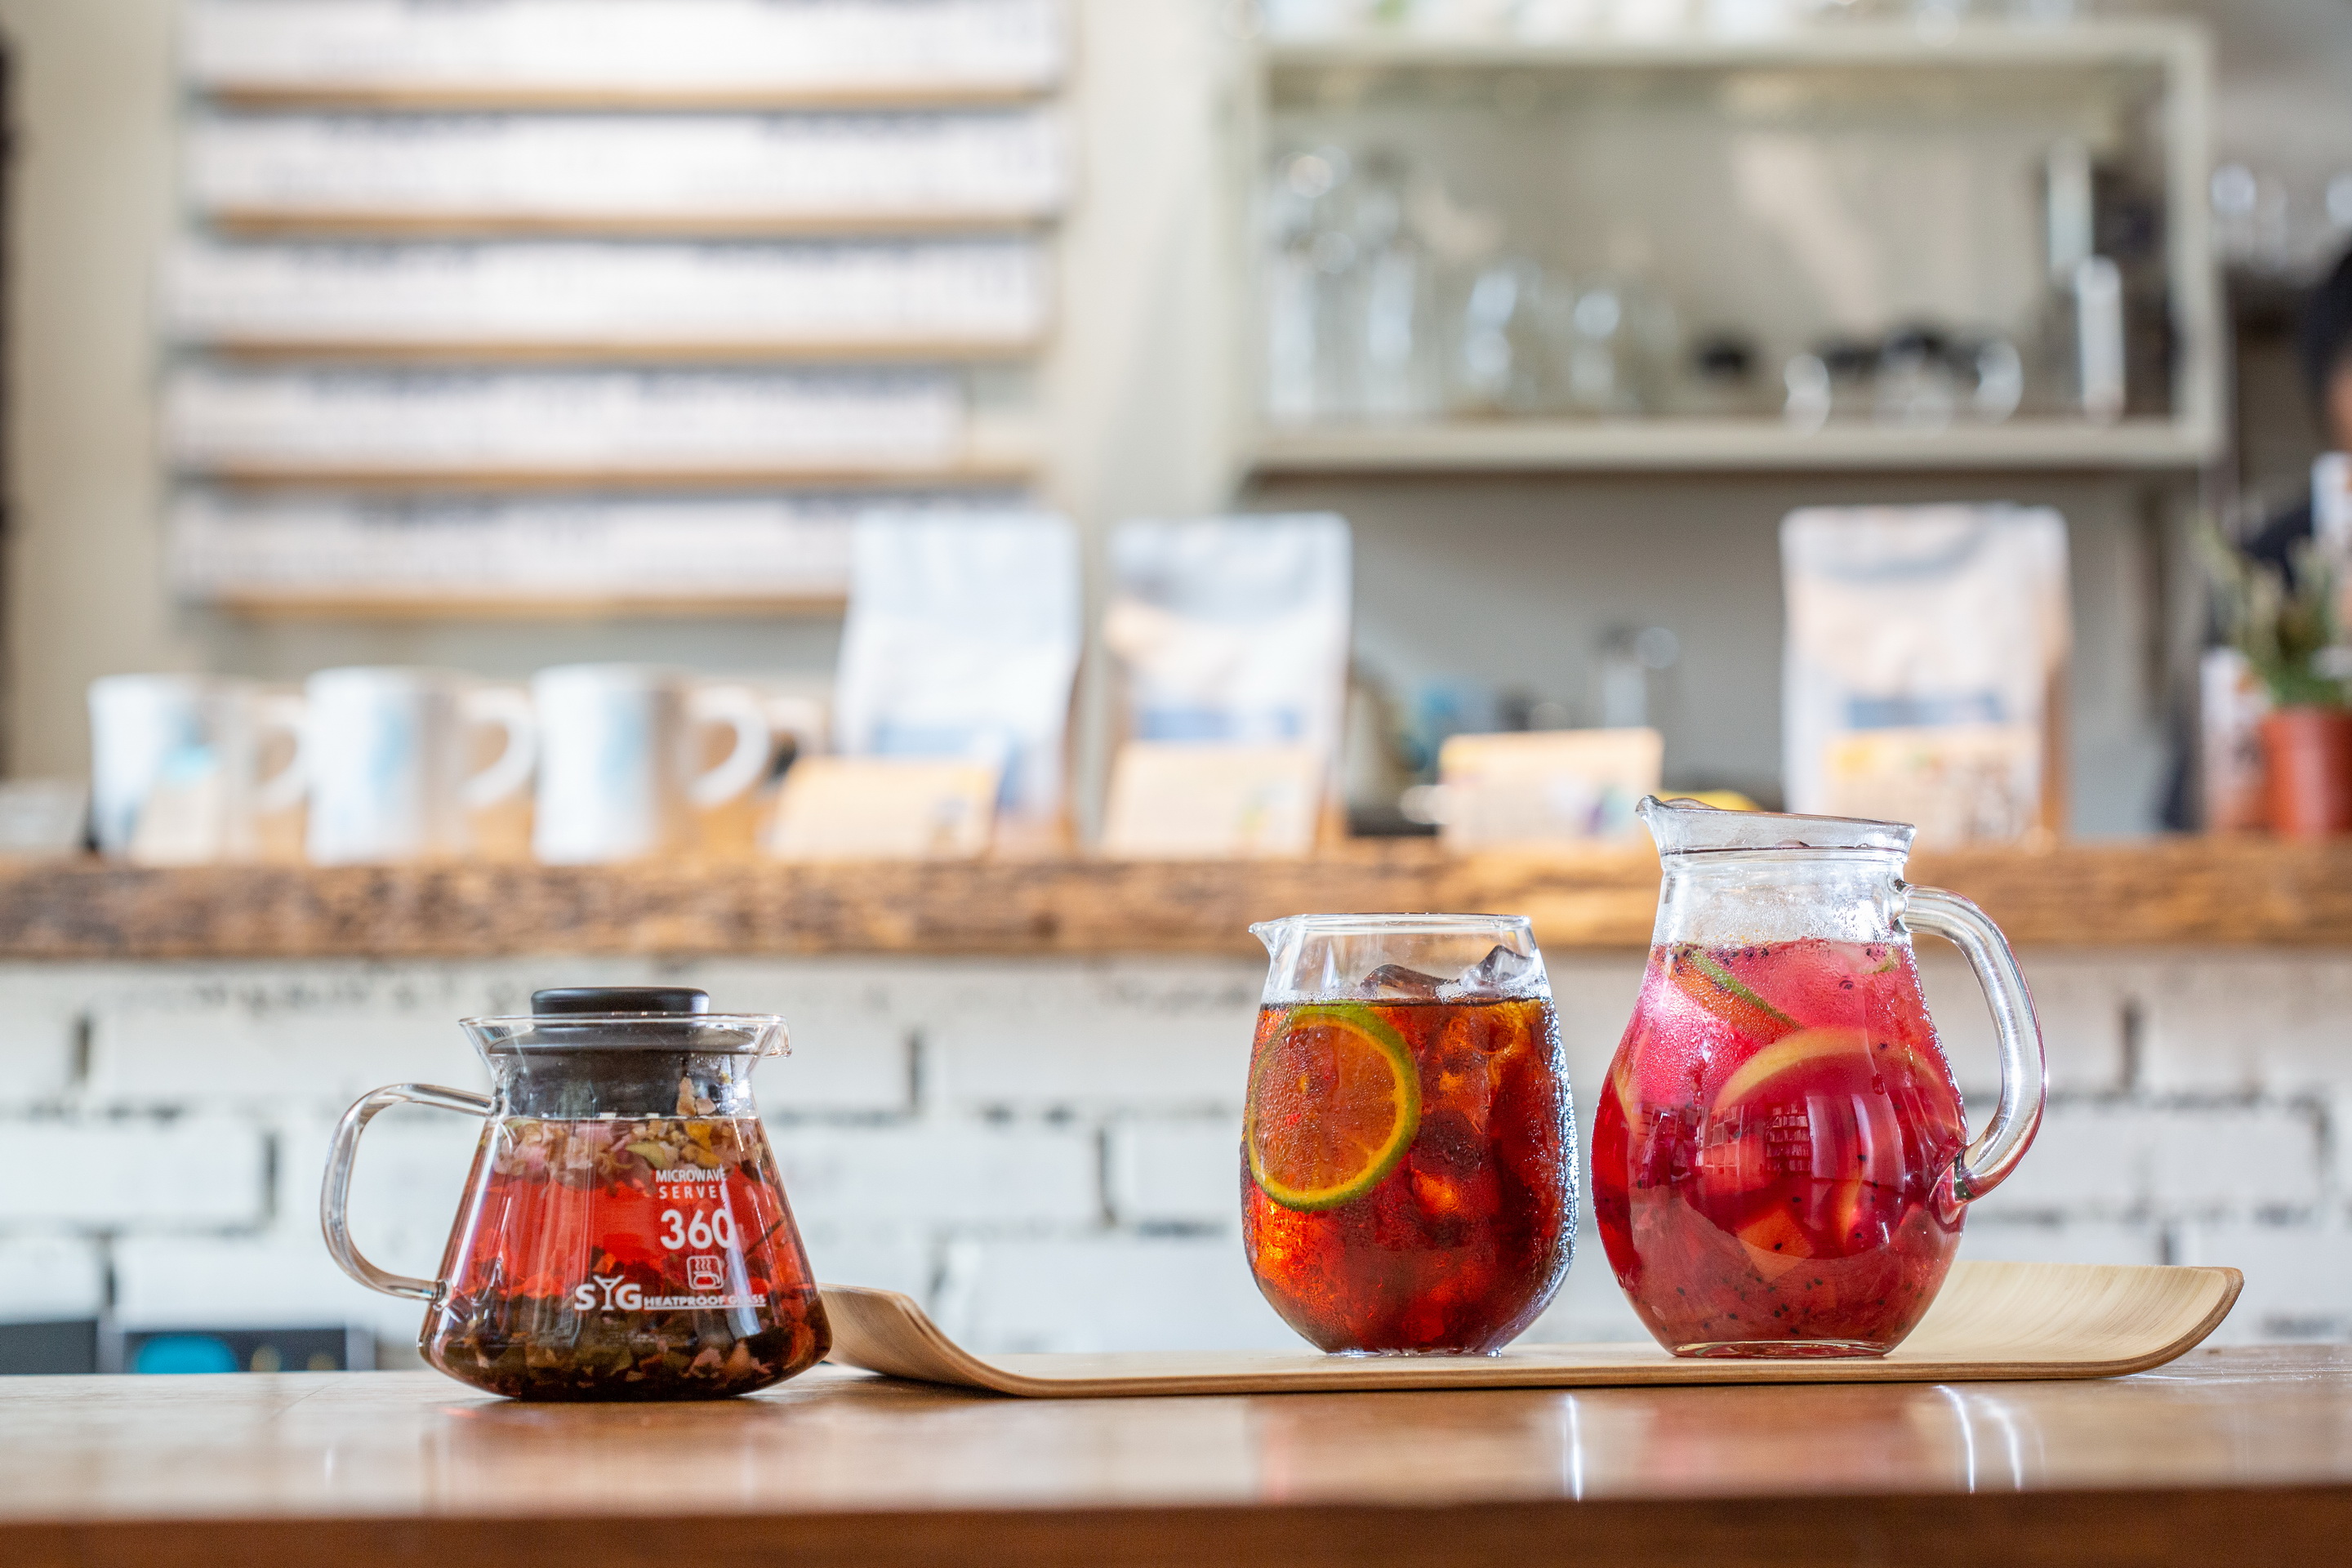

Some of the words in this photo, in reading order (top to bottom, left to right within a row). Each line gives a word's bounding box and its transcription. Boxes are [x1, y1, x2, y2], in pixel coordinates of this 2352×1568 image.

[655, 1169, 726, 1183] MICROWAVE
[660, 1209, 736, 1250] 360
[574, 1275, 642, 1311] SYG
[644, 1295, 724, 1307] HEATPROOF
